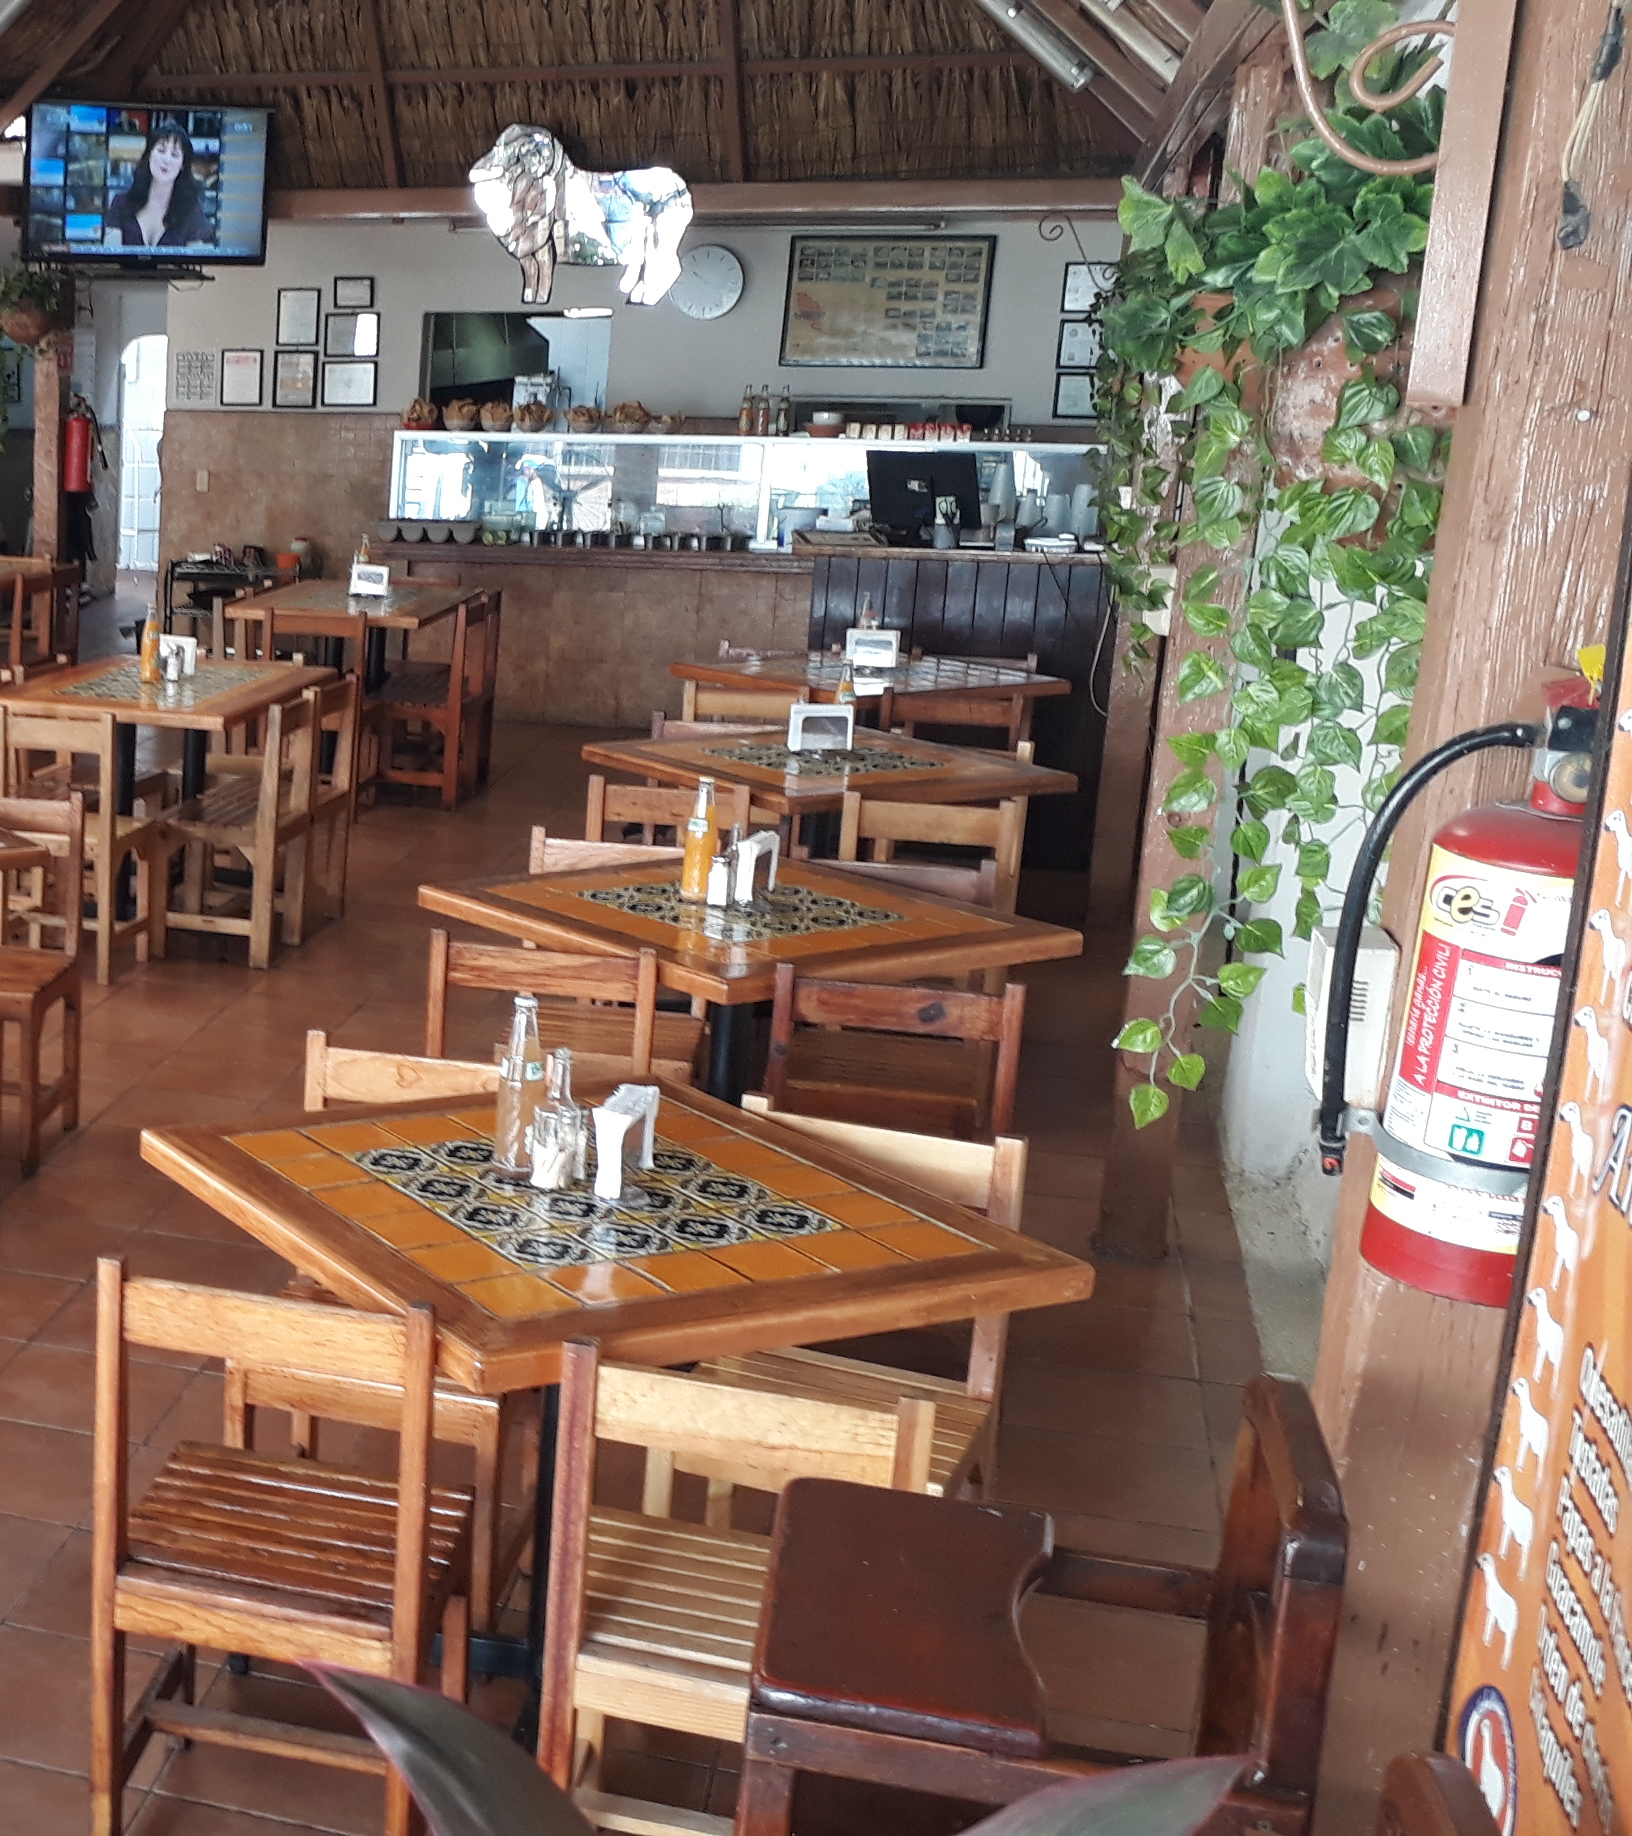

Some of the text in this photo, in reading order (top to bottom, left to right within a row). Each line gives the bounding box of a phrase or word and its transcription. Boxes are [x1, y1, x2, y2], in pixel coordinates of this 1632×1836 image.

[1417, 976, 1444, 1056] PROTECCIÓN
[1415, 1053, 1431, 1075] LA
[1457, 1089, 1523, 1111] EXTINTOR
[1546, 1540, 1607, 1697] Guacamole
